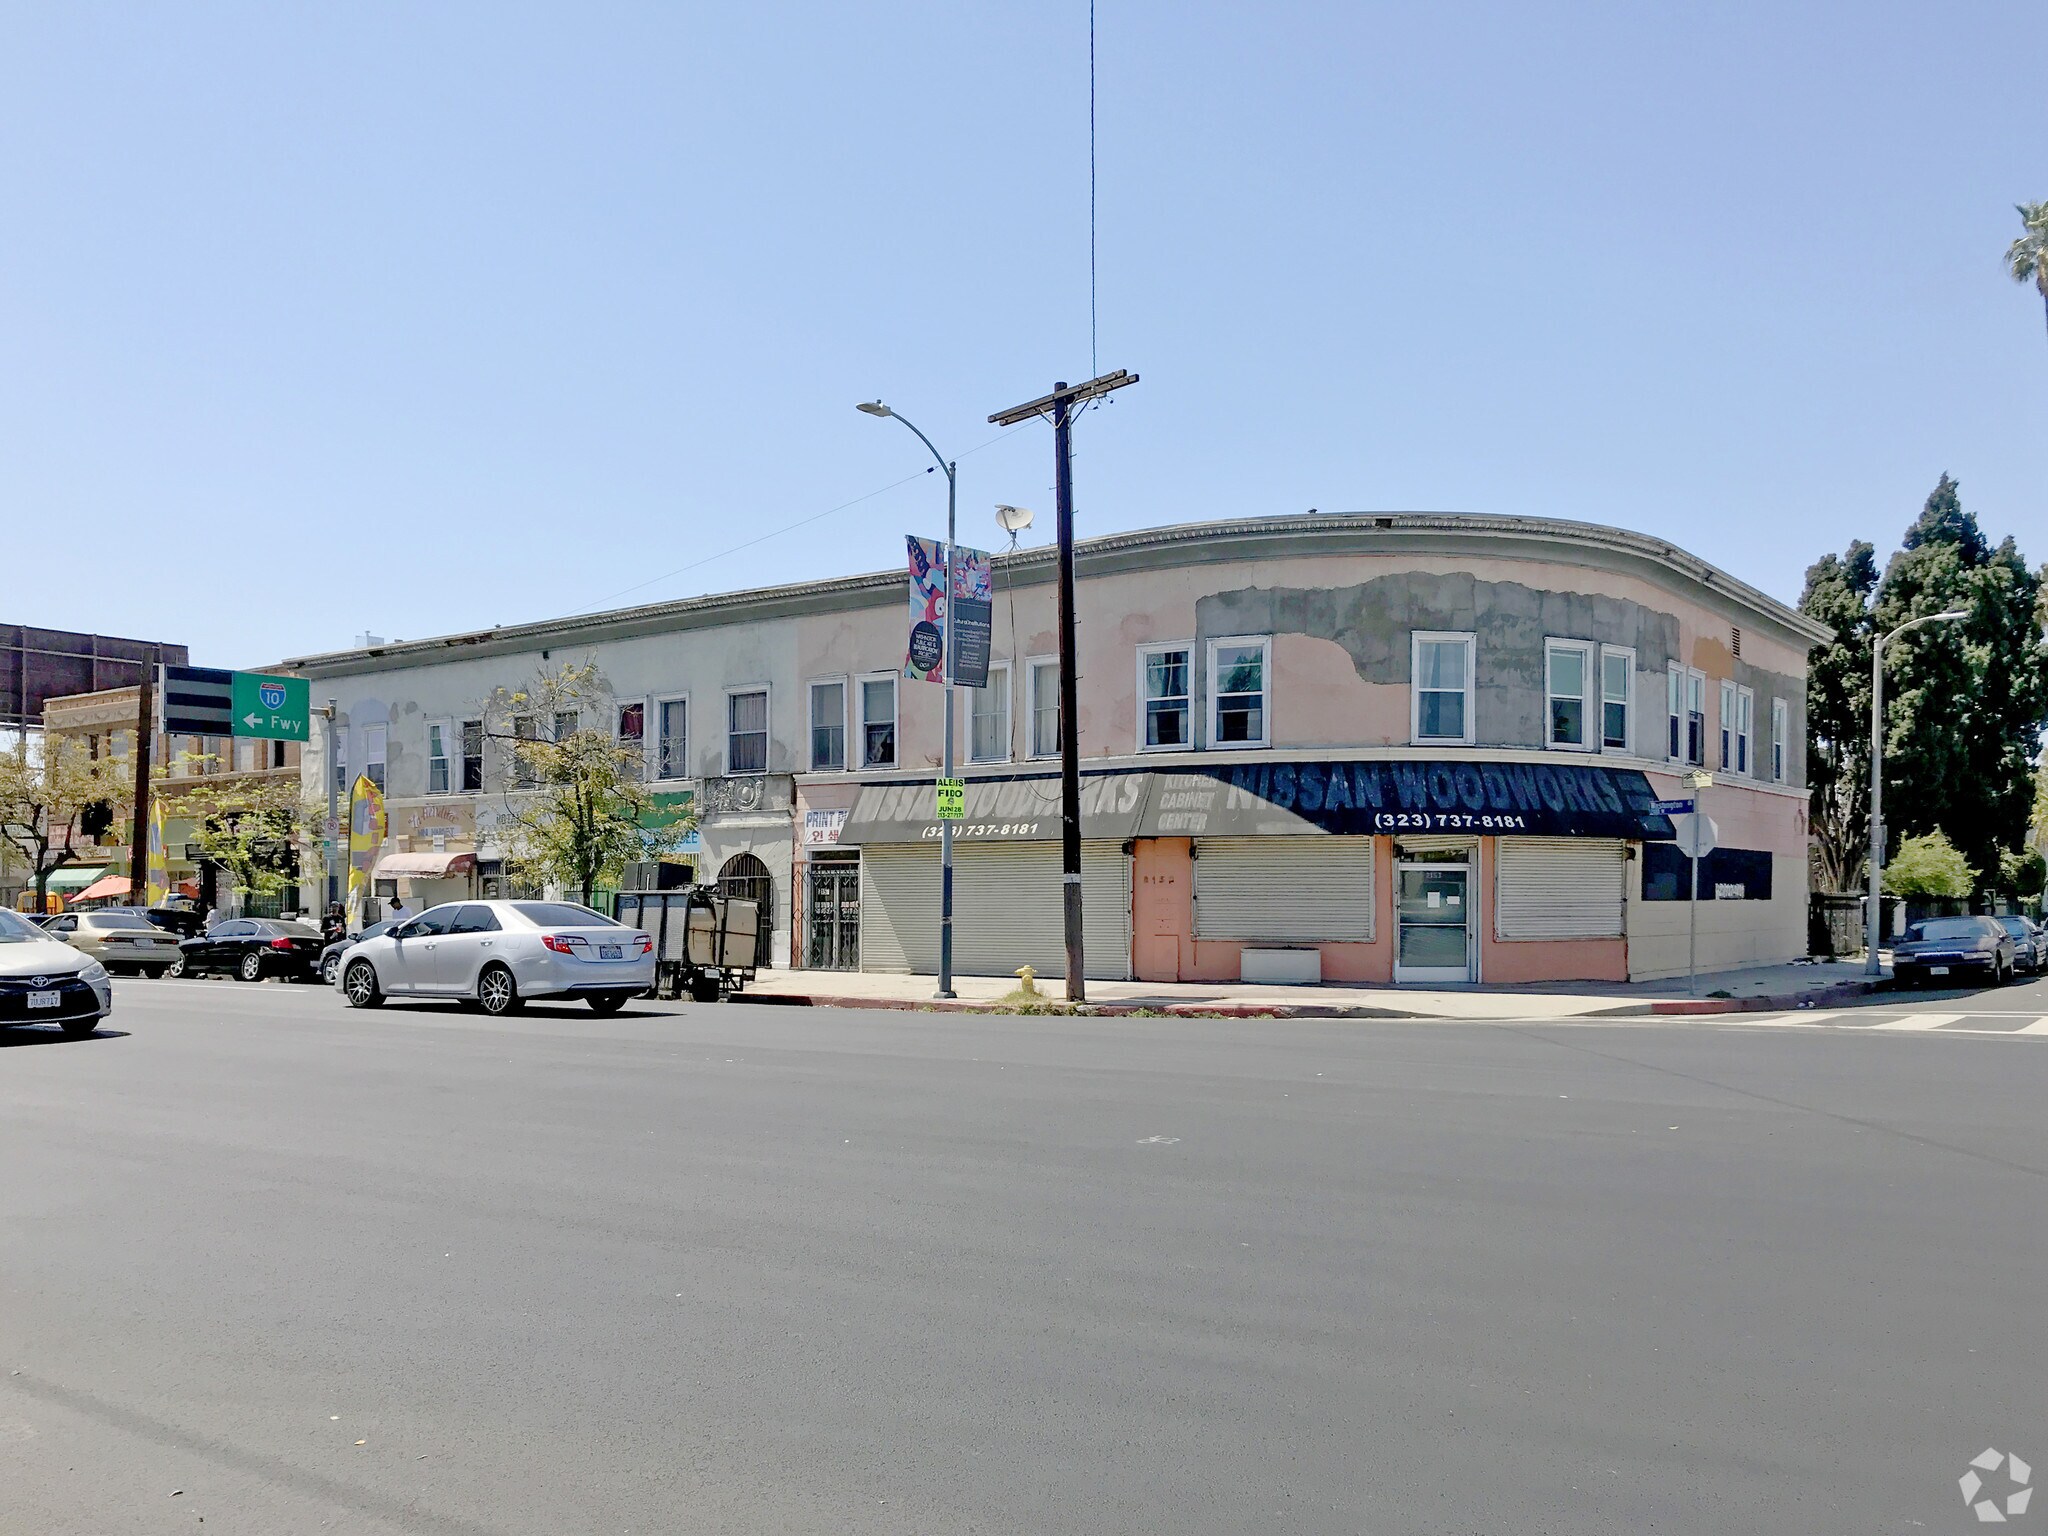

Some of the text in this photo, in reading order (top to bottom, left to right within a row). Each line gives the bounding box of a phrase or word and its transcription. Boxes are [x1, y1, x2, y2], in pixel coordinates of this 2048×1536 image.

[266, 692, 280, 705] 10
[271, 715, 302, 734] Fwy
[1226, 763, 1384, 811] NISSAN
[1389, 763, 1624, 814] WOODWORKS
[851, 782, 940, 822] NISSA
[1160, 792, 1215, 809] CABINET
[806, 811, 835, 828] PRINT
[1157, 812, 1208, 831] CENTER
[1374, 813, 1525, 829] (323) 737-8181
[965, 823, 1039, 837] 737-8181
